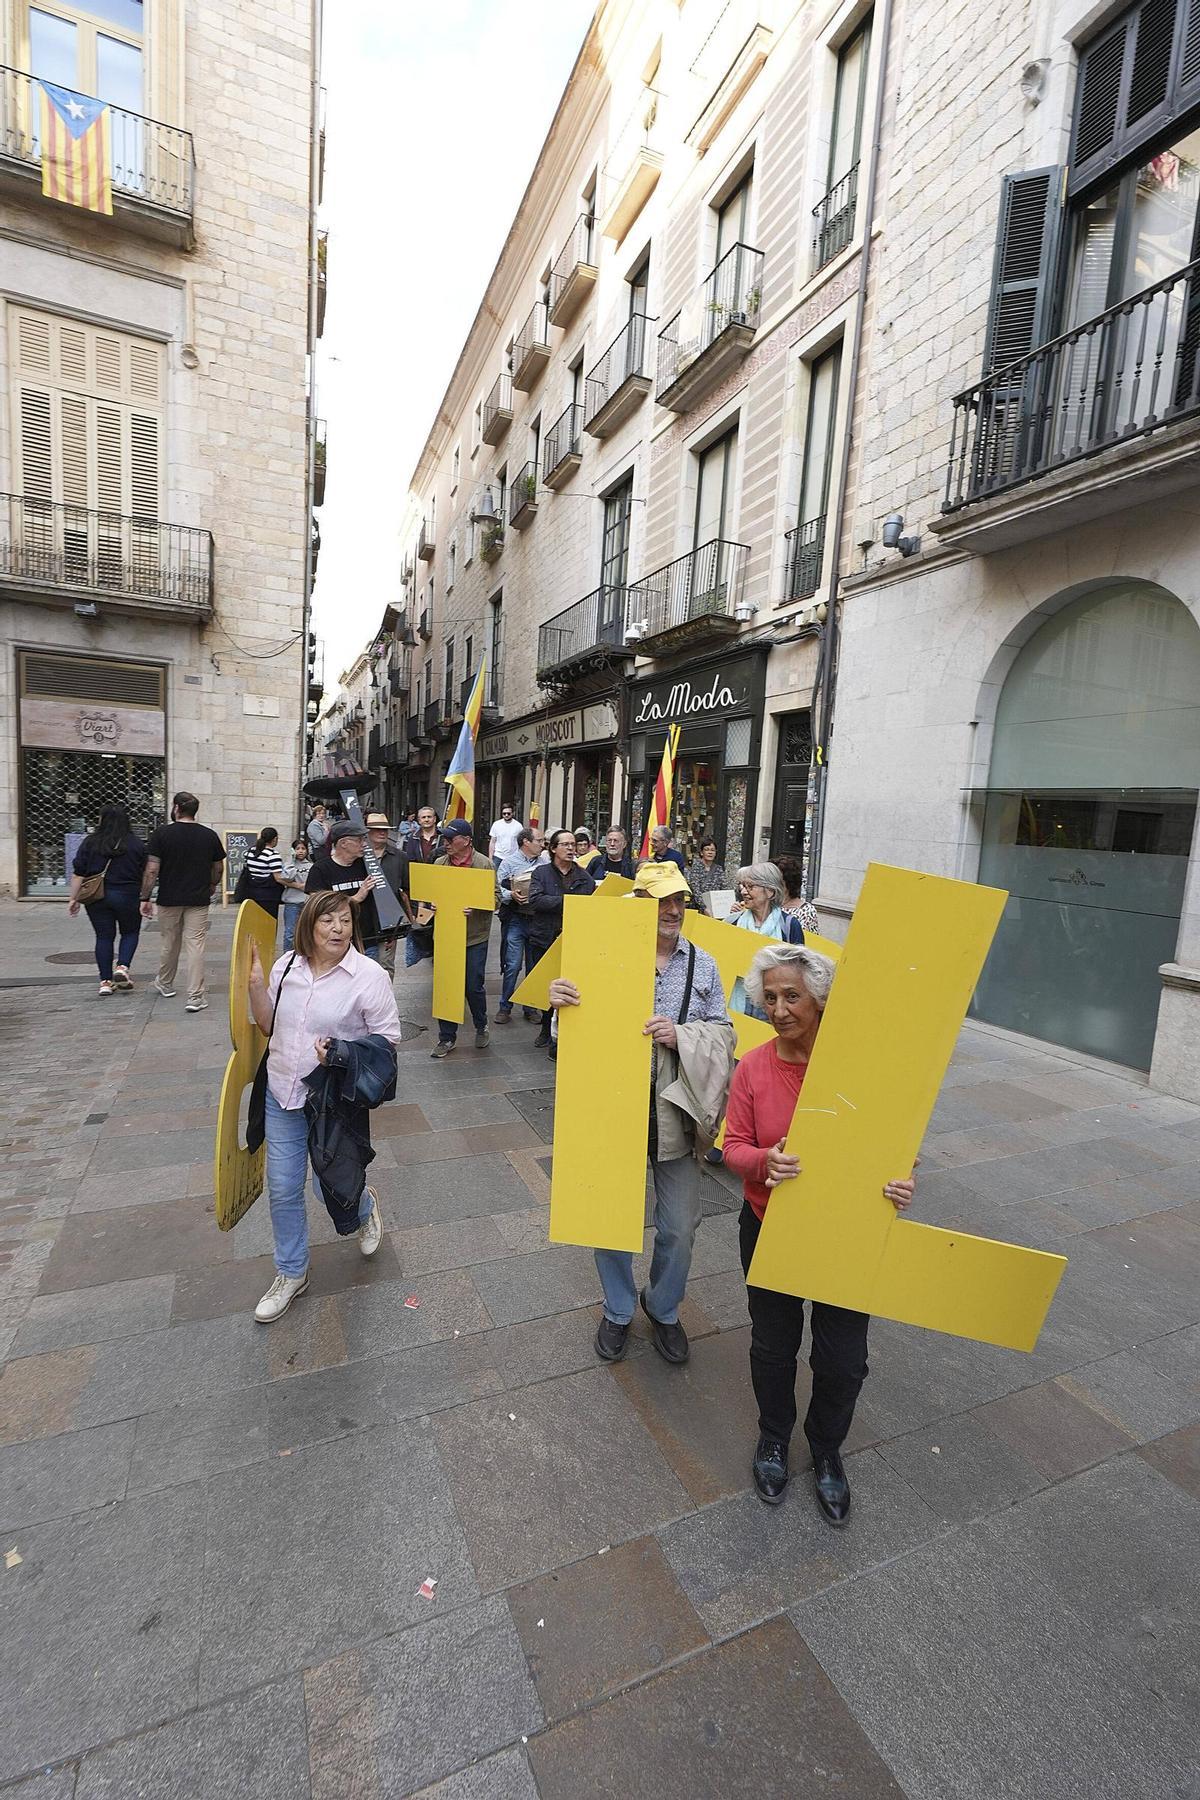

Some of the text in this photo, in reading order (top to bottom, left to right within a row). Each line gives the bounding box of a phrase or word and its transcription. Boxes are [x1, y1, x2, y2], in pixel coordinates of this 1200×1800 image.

[635, 692, 663, 722] La
[663, 674, 738, 718] Moda
[227, 833, 248, 847] BAR
